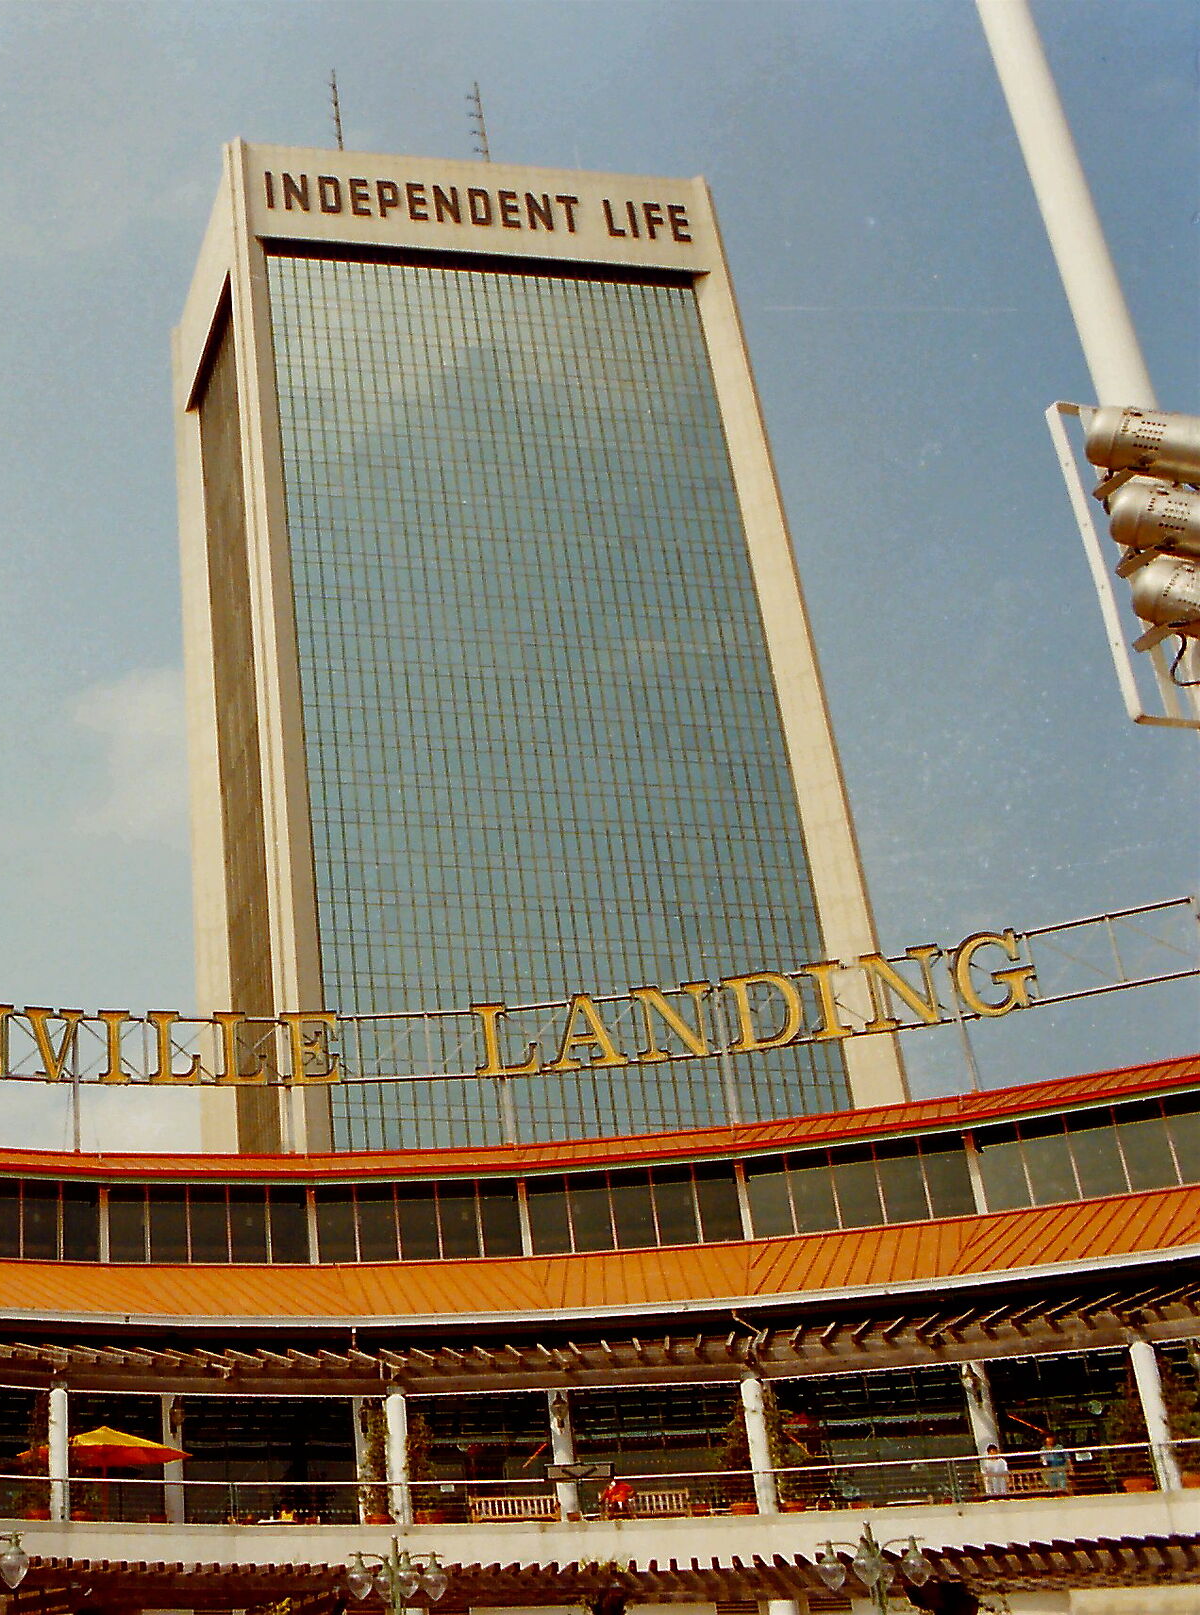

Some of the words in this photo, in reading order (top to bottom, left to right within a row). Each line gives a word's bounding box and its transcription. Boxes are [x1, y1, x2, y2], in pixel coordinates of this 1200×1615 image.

[264, 171, 578, 231] INDEPENDENT
[604, 199, 691, 241] LIFE
[470, 930, 1037, 1077] LANDING
